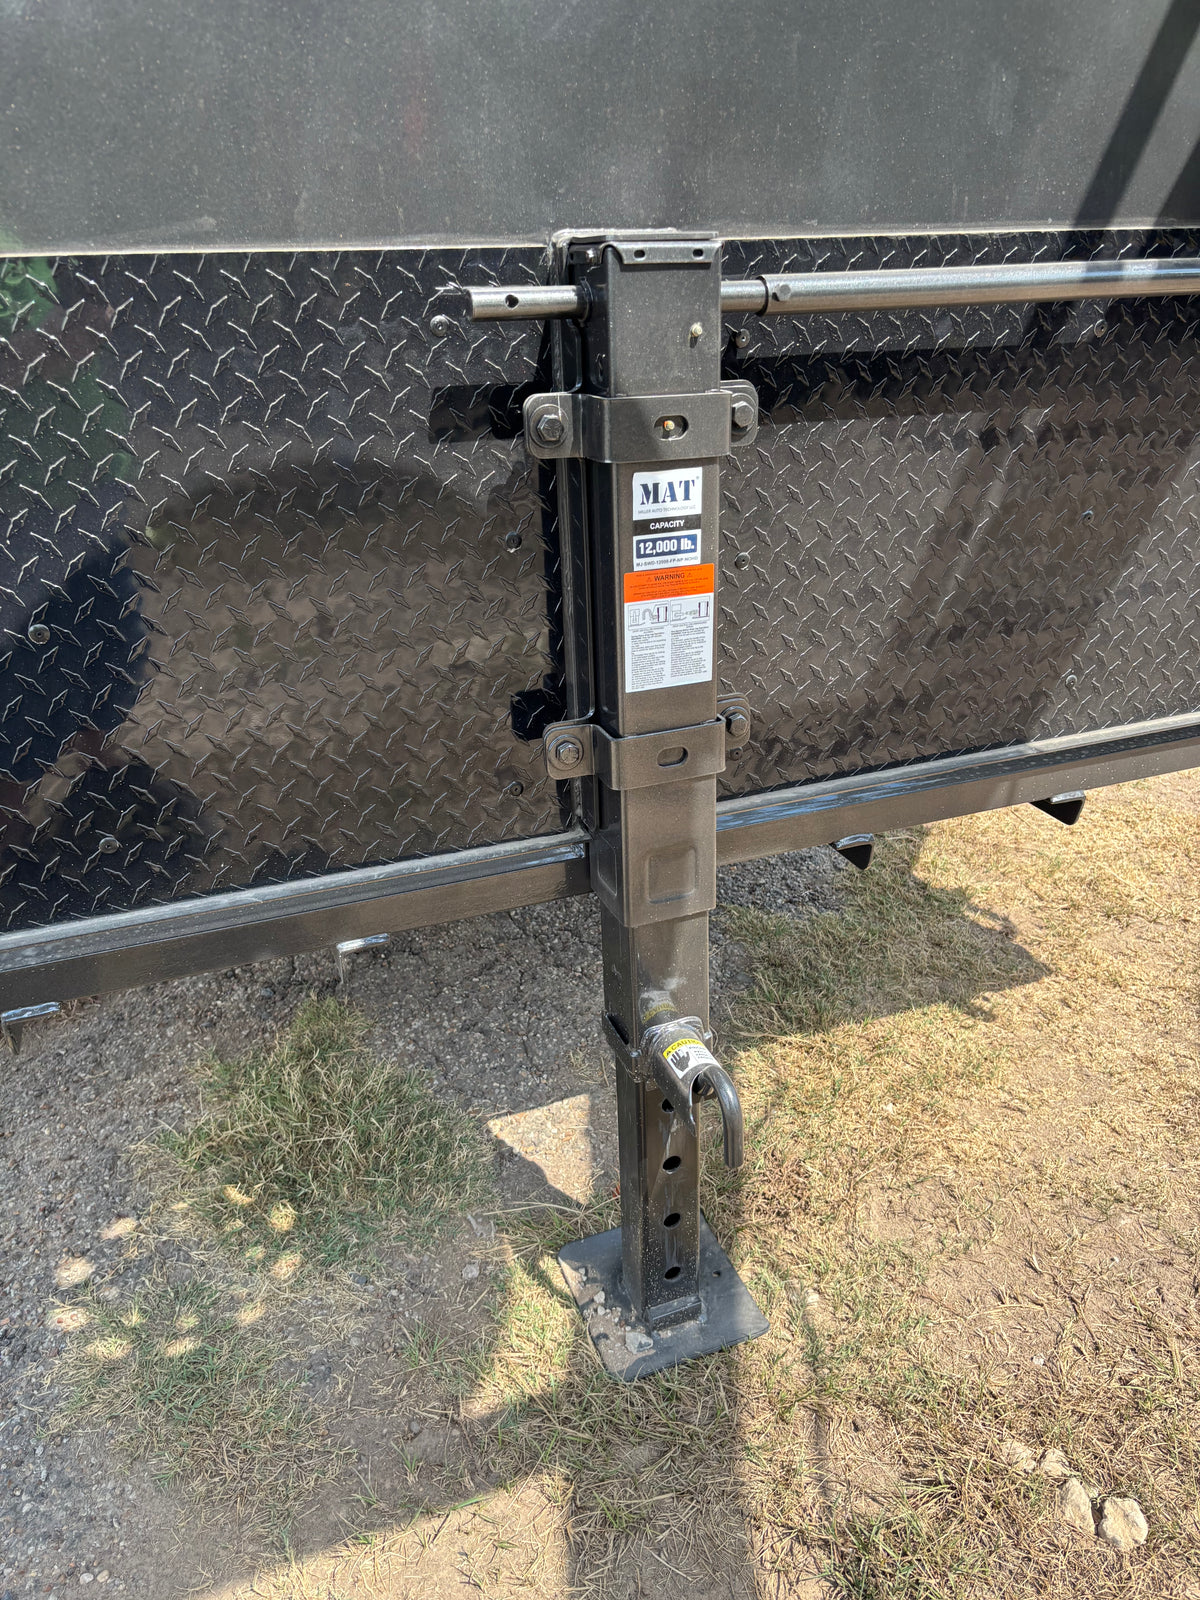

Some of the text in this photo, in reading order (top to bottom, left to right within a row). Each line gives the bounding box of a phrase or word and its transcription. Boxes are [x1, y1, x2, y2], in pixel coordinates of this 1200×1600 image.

[640, 480, 695, 505] MAT
[650, 519, 685, 530] CAPACITY
[639, 538, 695, 555] 12,000 lb.
[654, 573, 685, 581] WARNING
